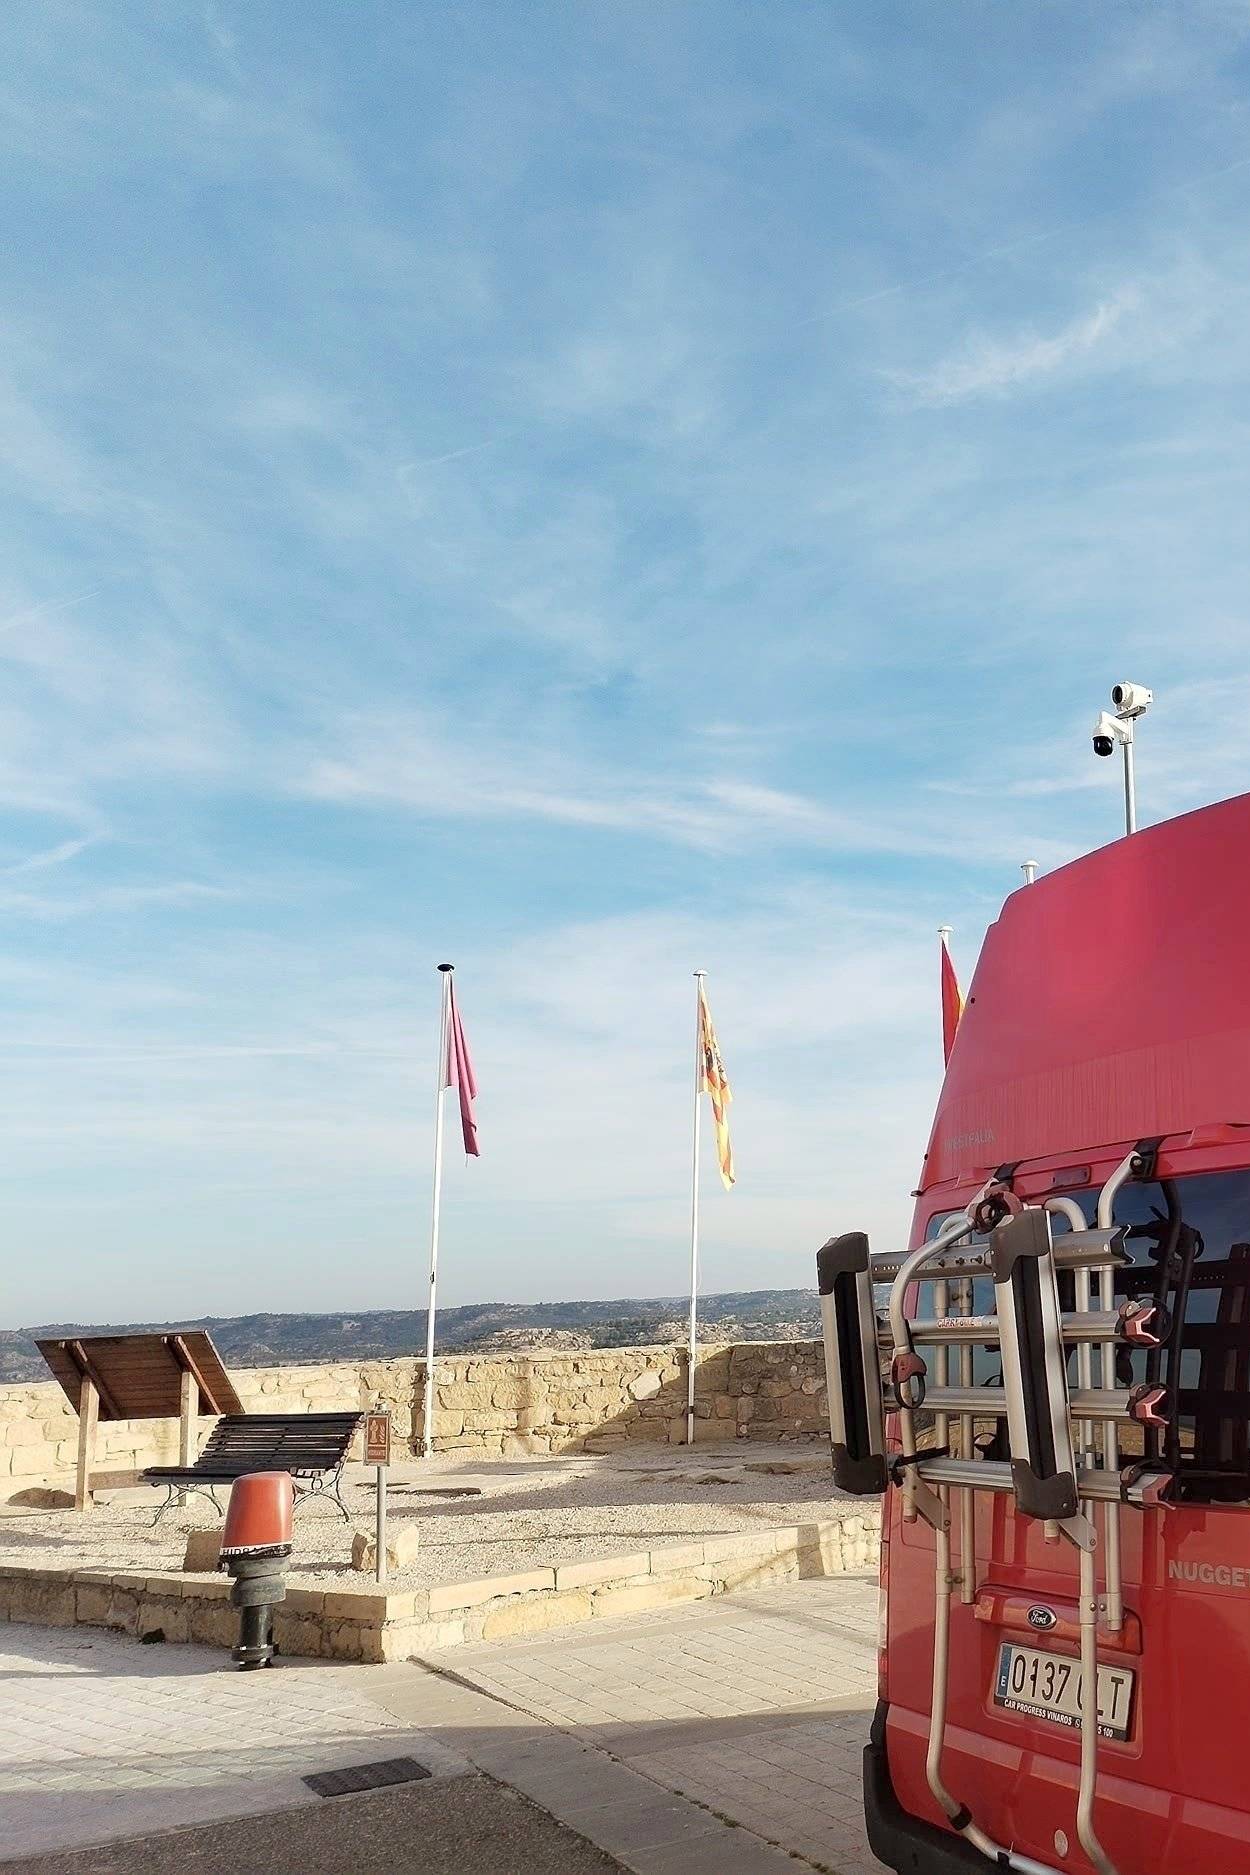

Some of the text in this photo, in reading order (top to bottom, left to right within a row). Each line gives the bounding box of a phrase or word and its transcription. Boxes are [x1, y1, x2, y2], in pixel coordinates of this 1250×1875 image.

[1030, 1609, 1049, 1625] Ford
[1000, 1675, 1007, 1687] E
[1012, 1654, 1072, 1704] 0137
[1004, 1699, 1016, 1711] CAR
[1016, 1702, 1047, 1719] PROGRESS
